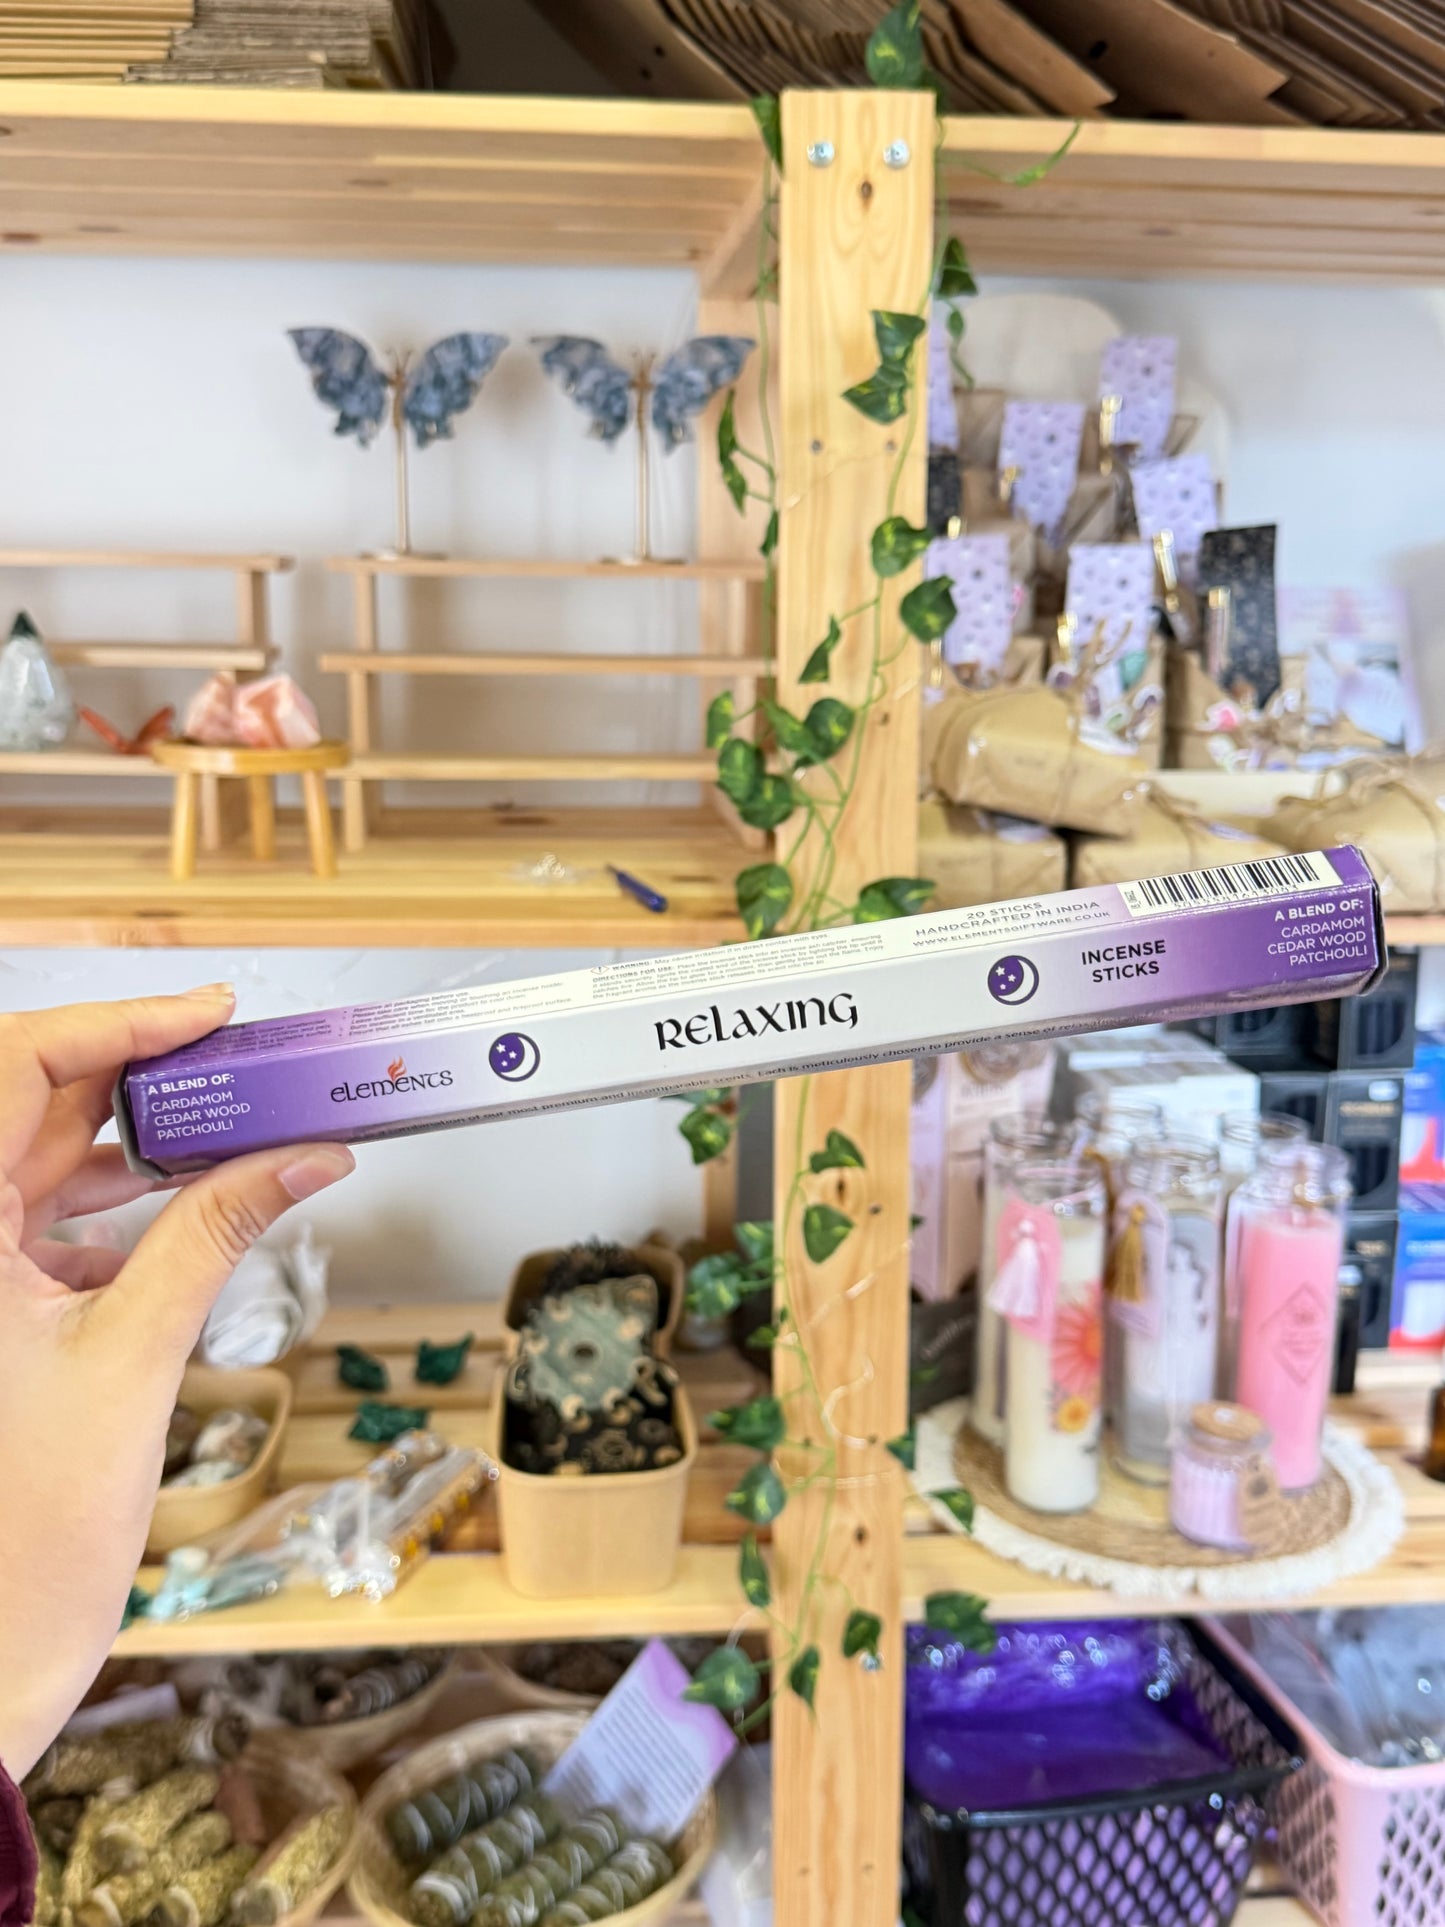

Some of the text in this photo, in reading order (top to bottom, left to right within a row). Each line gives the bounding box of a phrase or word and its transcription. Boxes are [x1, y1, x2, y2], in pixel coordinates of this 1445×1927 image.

[915, 900, 1100, 937] HANDCRAFTED IN INDIA
[967, 901, 1042, 919] 20 STICKS
[1274, 899, 1364, 922] A BLEND OF:
[1282, 916, 1365, 938] CARDAMOM
[1082, 940, 1166, 965] INCENSE
[1268, 931, 1366, 955] CEDAR WOOD
[1290, 945, 1367, 966] PATCHOULI
[1092, 960, 1159, 982] STICKS
[654, 993, 858, 1050] RELAXING
[148, 1073, 235, 1095] A BLEND OF:
[330, 1070, 454, 1102] elements
[151, 1091, 233, 1112] CARDAMOM
[154, 1103, 250, 1126] CEDAR WOOD
[157, 1120, 233, 1140] PATCHOULI
